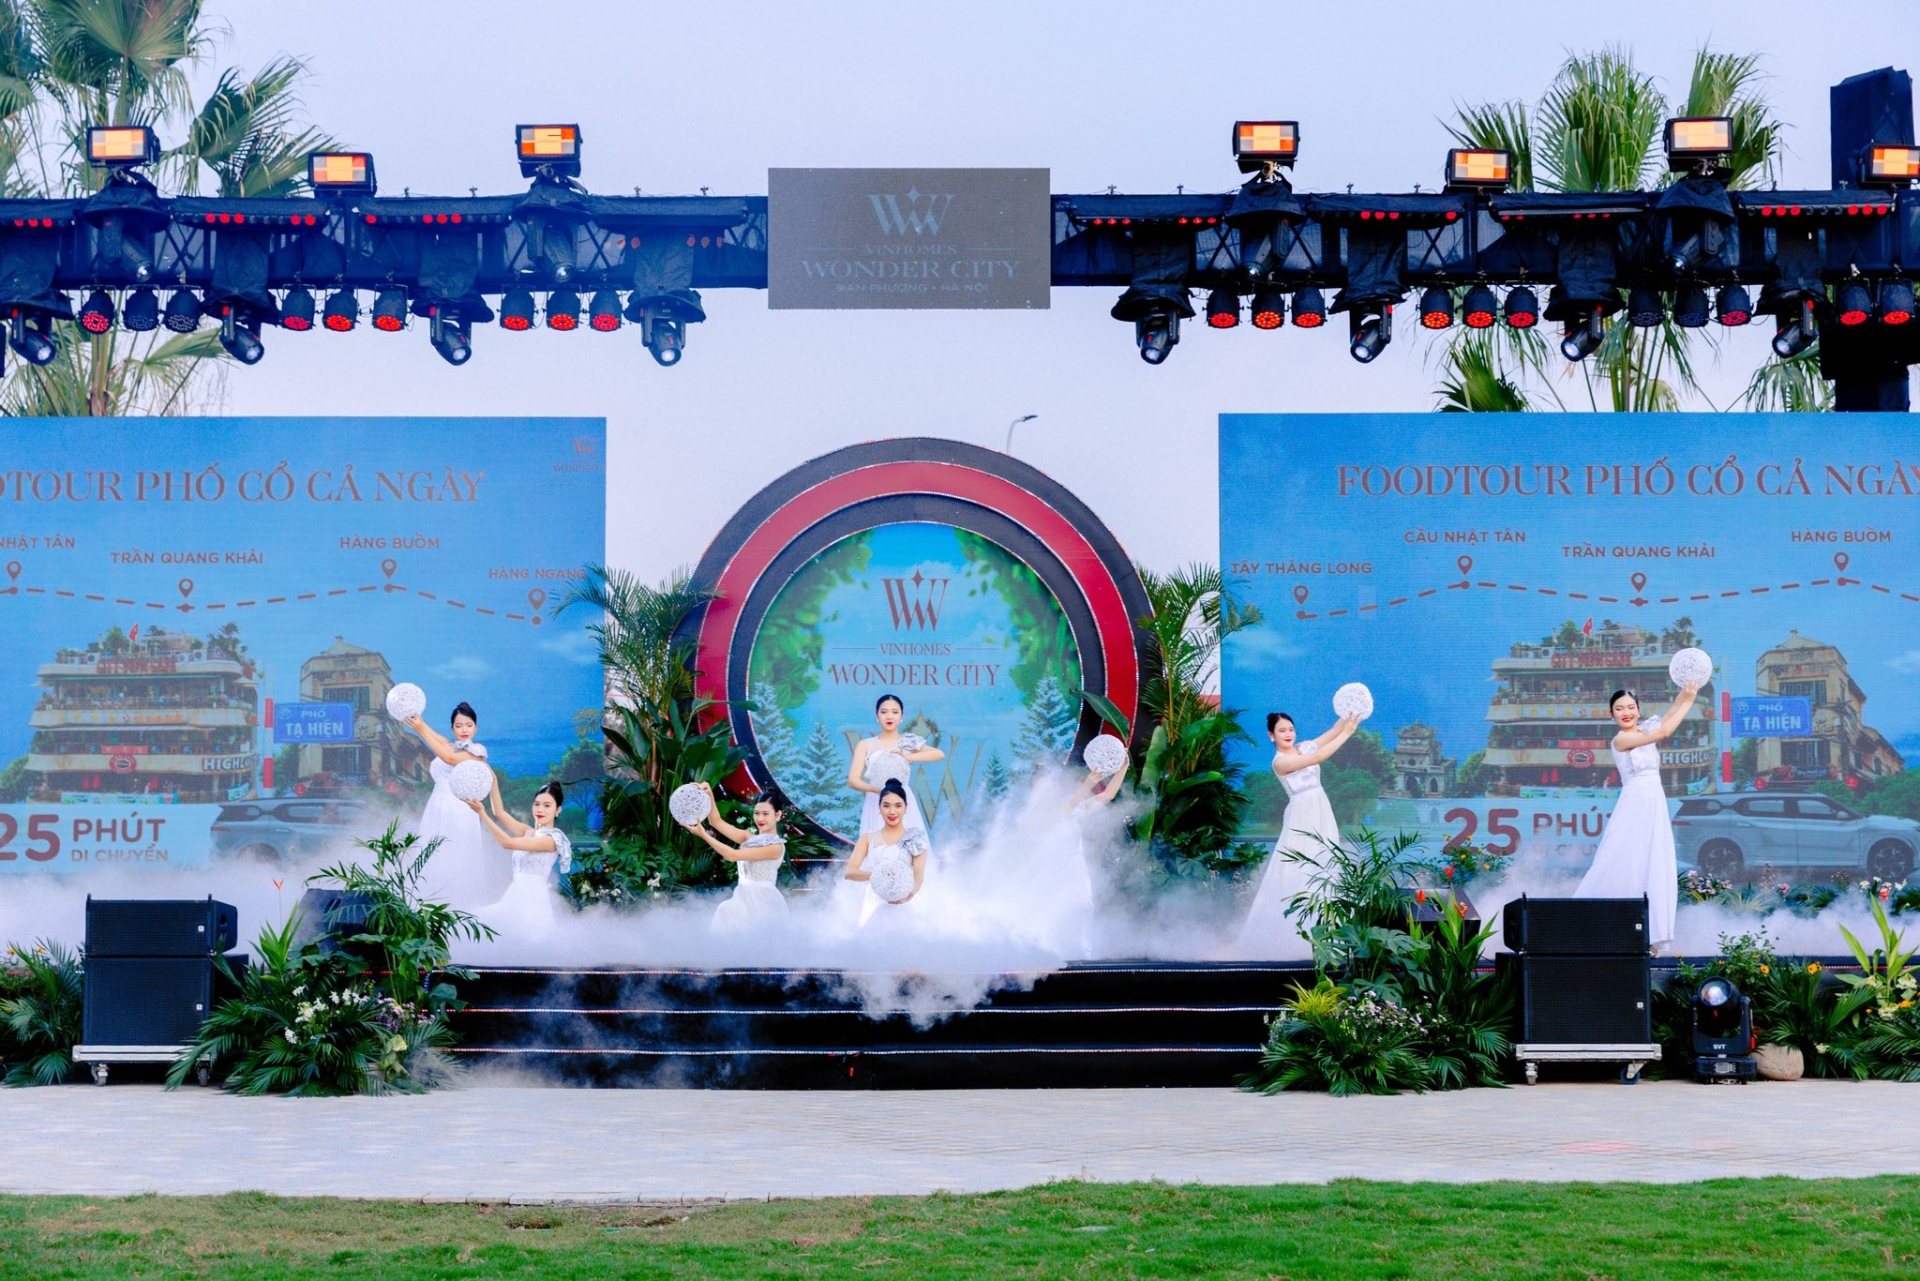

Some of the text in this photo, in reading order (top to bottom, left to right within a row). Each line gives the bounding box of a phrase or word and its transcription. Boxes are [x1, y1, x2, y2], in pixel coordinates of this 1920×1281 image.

[865, 244, 957, 255] VINHOMES
[801, 260, 1021, 279] WONDER CITY
[0, 459, 487, 502] TOUR PHỐ CỔ CẢ NGÀY
[1336, 465, 1574, 496] FOODTOUR
[1585, 455, 1675, 496] PHỐ
[1686, 454, 1745, 496] CỔ
[1756, 457, 1813, 496] CẢ
[44, 533, 76, 549] TÂN
[340, 532, 440, 549] HÀNG BUỒM
[1404, 526, 1526, 546] CẦU NHẬT TÂN
[1791, 526, 1891, 543] HÀNG BUỒM
[110, 547, 263, 565] TRẦN QUANG KHẢI
[1562, 541, 1715, 559] TRẦN QUANG KHẢI
[489, 565, 587, 579] HÀNG NGANG
[1231, 559, 1373, 574] TÂY THĂNG LONG
[879, 643, 951, 656] VINHOMES
[830, 663, 1000, 687] WONDER CITY
[301, 707, 327, 718] PHỐ
[1758, 701, 1784, 712] PHỐ
[285, 722, 303, 738] TẠ
[308, 719, 344, 738] HIỆN
[1743, 716, 1762, 731] TẠ
[1765, 713, 1802, 732] HIỆN
[73, 811, 166, 843] PHÚT
[1533, 806, 1612, 838] PHÚ
[1442, 807, 1521, 857] 25
[71, 844, 168, 862] DI CHUYỂN
